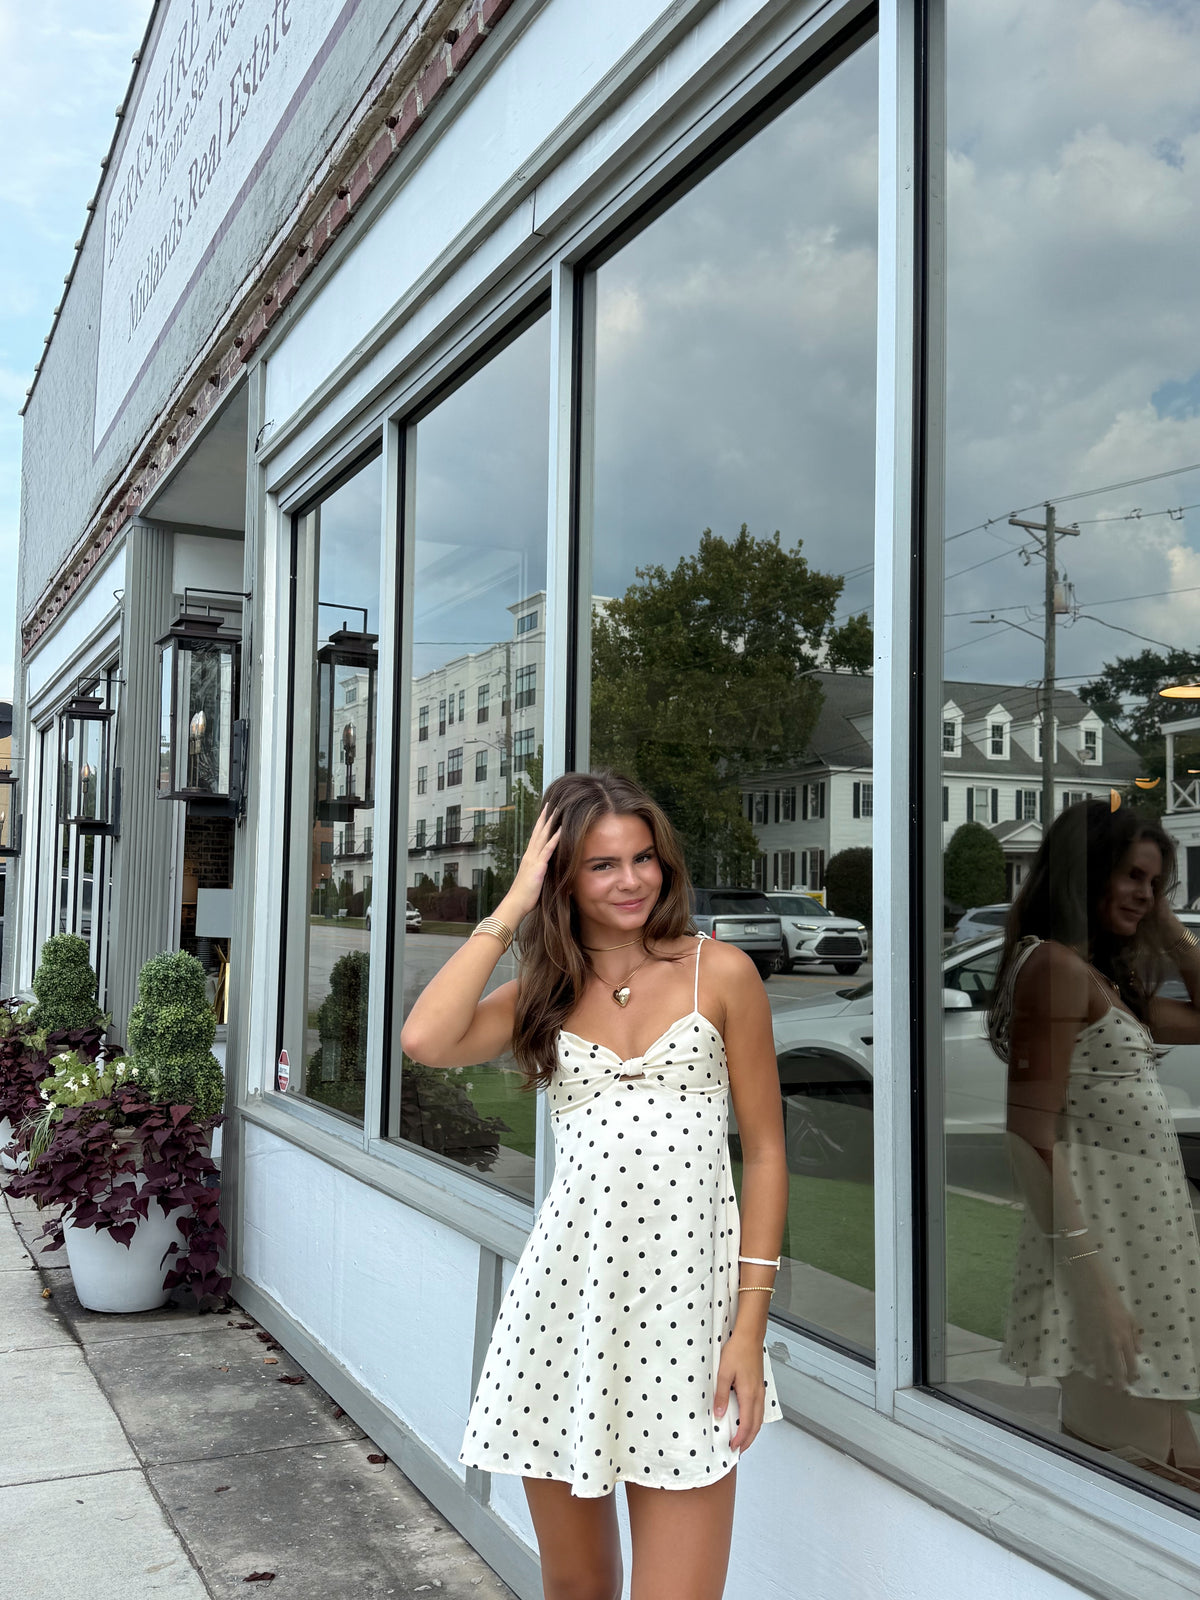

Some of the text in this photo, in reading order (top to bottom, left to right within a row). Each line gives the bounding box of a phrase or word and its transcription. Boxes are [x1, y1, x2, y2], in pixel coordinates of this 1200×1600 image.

[108, 0, 200, 269] BERKSHIRE
[128, 194, 184, 343] Midlands
[186, 96, 223, 227] Real
